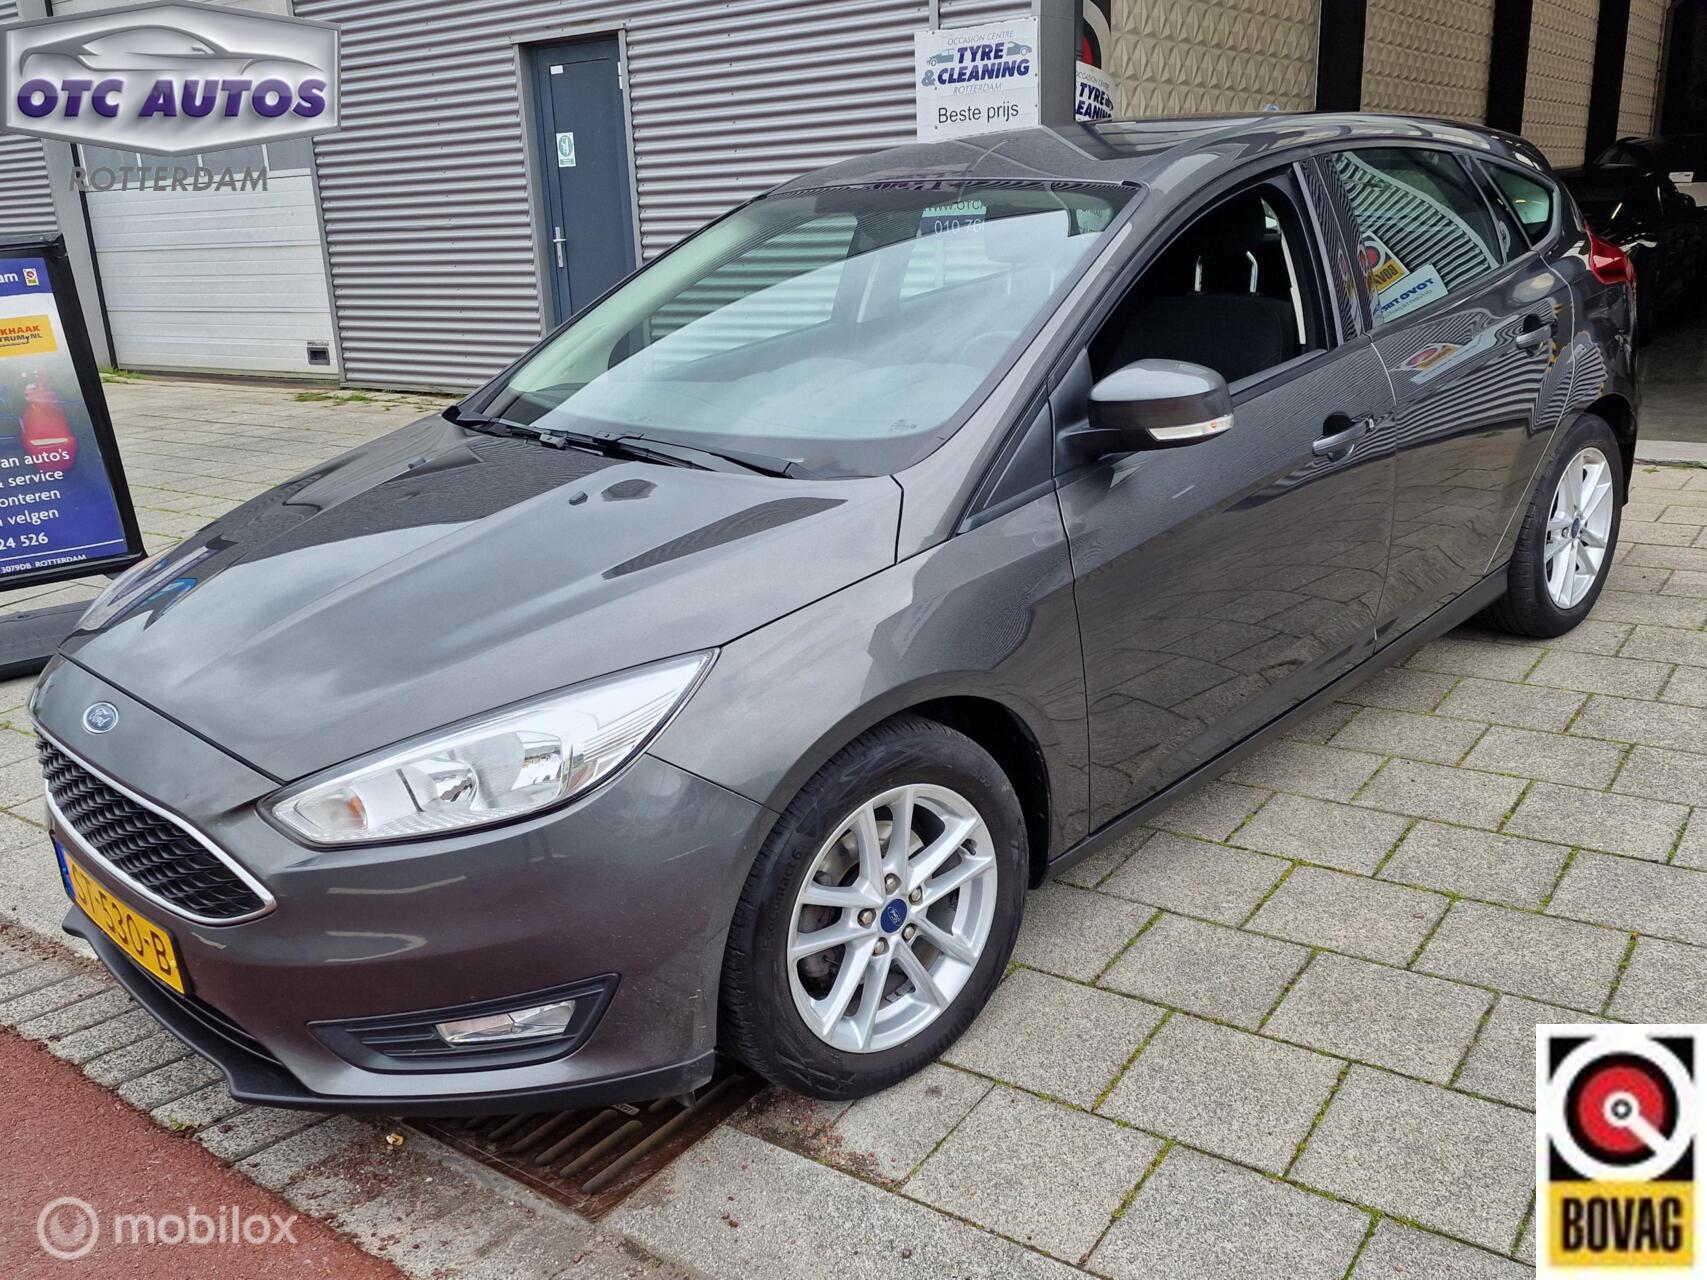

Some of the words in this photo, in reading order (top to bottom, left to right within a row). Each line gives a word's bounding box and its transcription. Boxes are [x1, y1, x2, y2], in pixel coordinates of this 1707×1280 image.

[947, 34, 985, 46] OCCASION
[987, 30, 1015, 40] CENTRE
[957, 42, 1005, 64] TYRE
[921, 69, 936, 87] &
[937, 58, 1030, 85] CLEANING
[952, 83, 1002, 95] ROTTERDAM
[1079, 82, 1105, 106] TYRE
[938, 105, 982, 123] Beste
[987, 100, 1019, 123] prijs
[934, 220, 960, 235] 010
[965, 218, 985, 233] 76
[24, 448, 70, 465] auto's
[8, 470, 64, 487] service
[0, 489, 61, 508] onteren
[7, 508, 59, 526] velgen
[21, 532, 49, 547] 526
[35, 554, 87, 568] ROTTERDAM
[71, 863, 172, 976] ST-530-B
